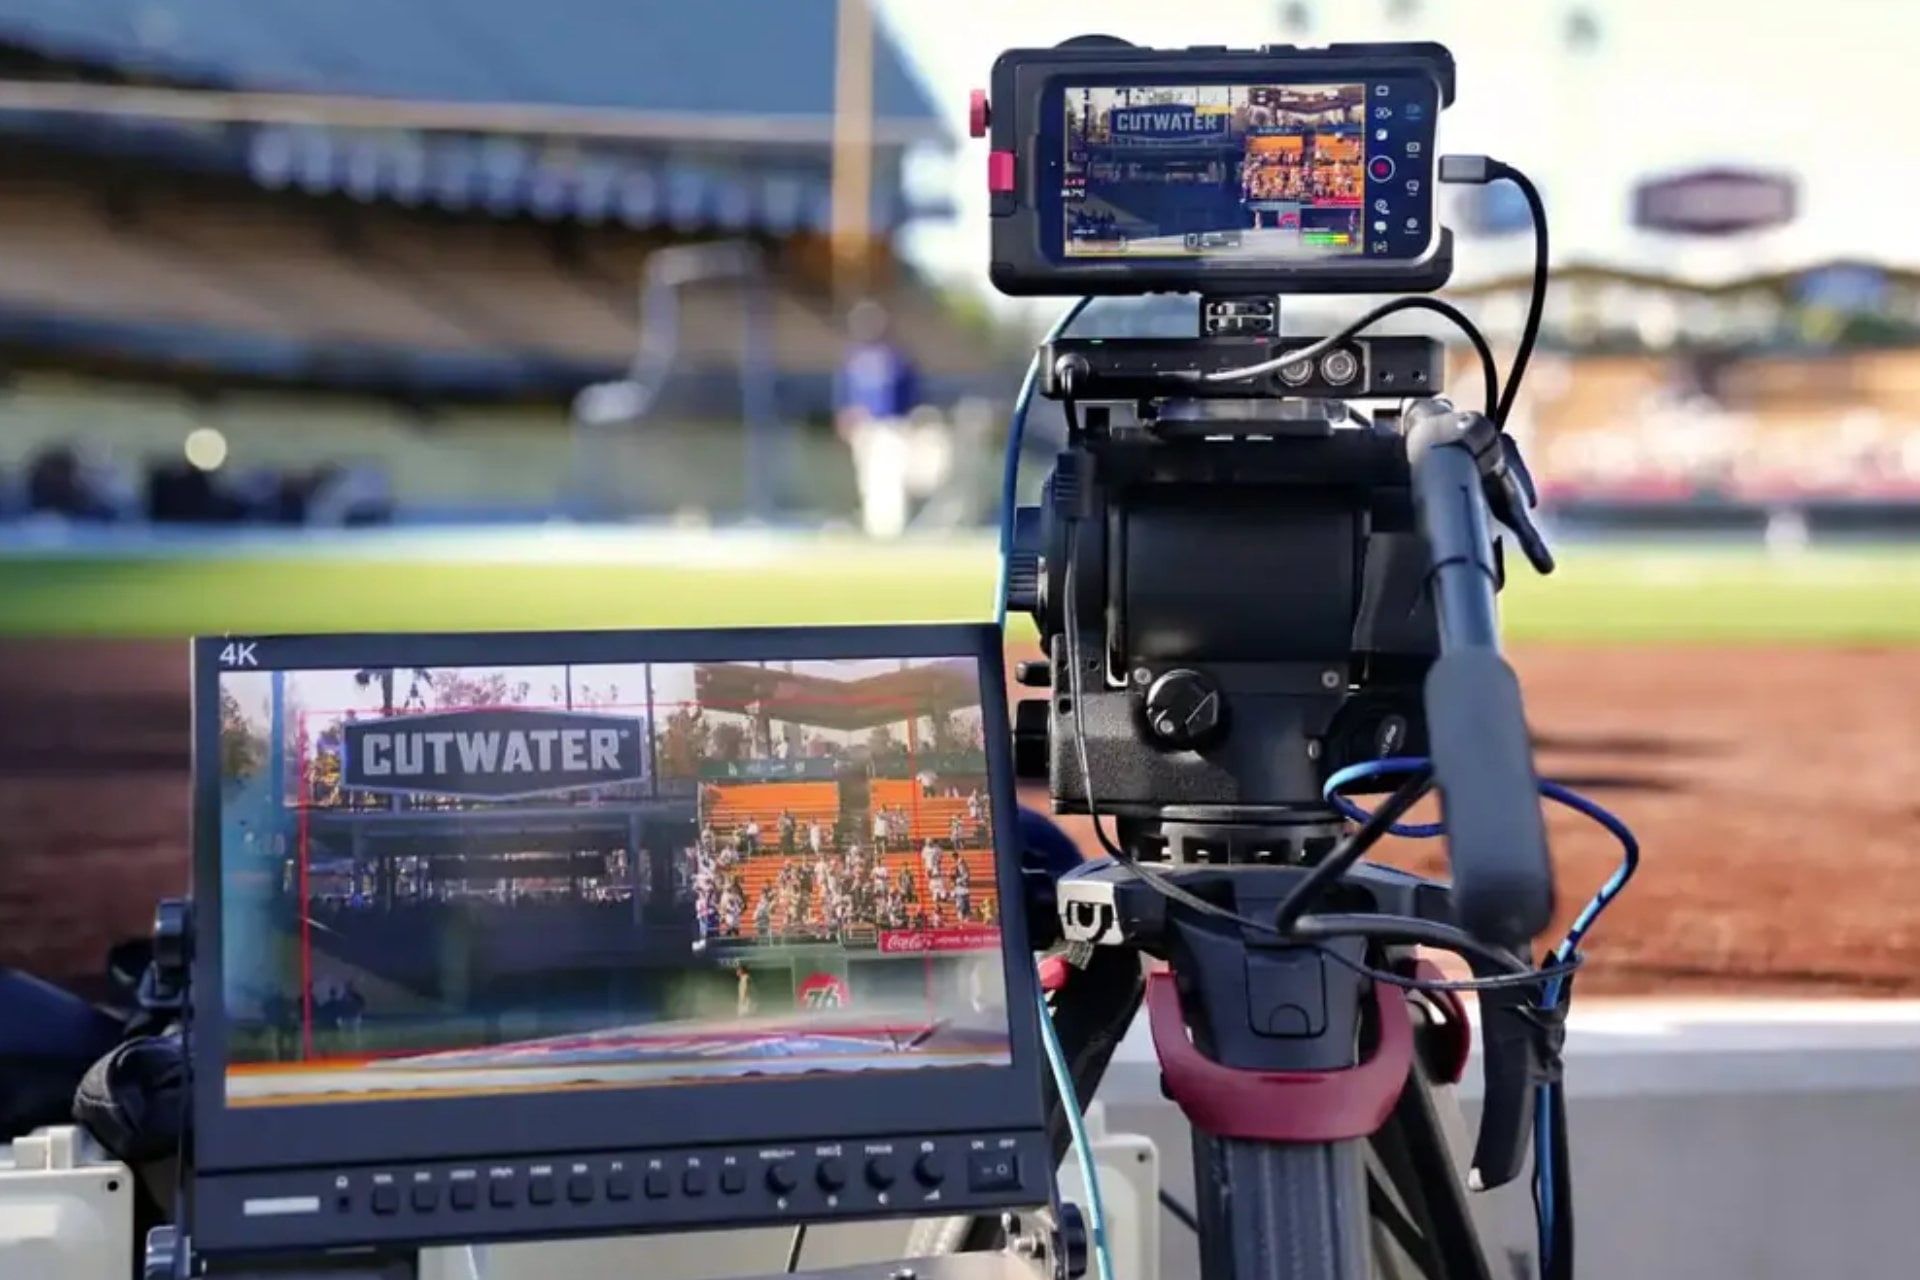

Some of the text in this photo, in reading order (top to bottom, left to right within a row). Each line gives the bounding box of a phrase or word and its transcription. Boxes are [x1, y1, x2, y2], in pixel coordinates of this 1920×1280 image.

[1115, 112, 1219, 133] CUTWATER
[219, 642, 258, 666] 4K
[362, 728, 622, 777] CUTWATER
